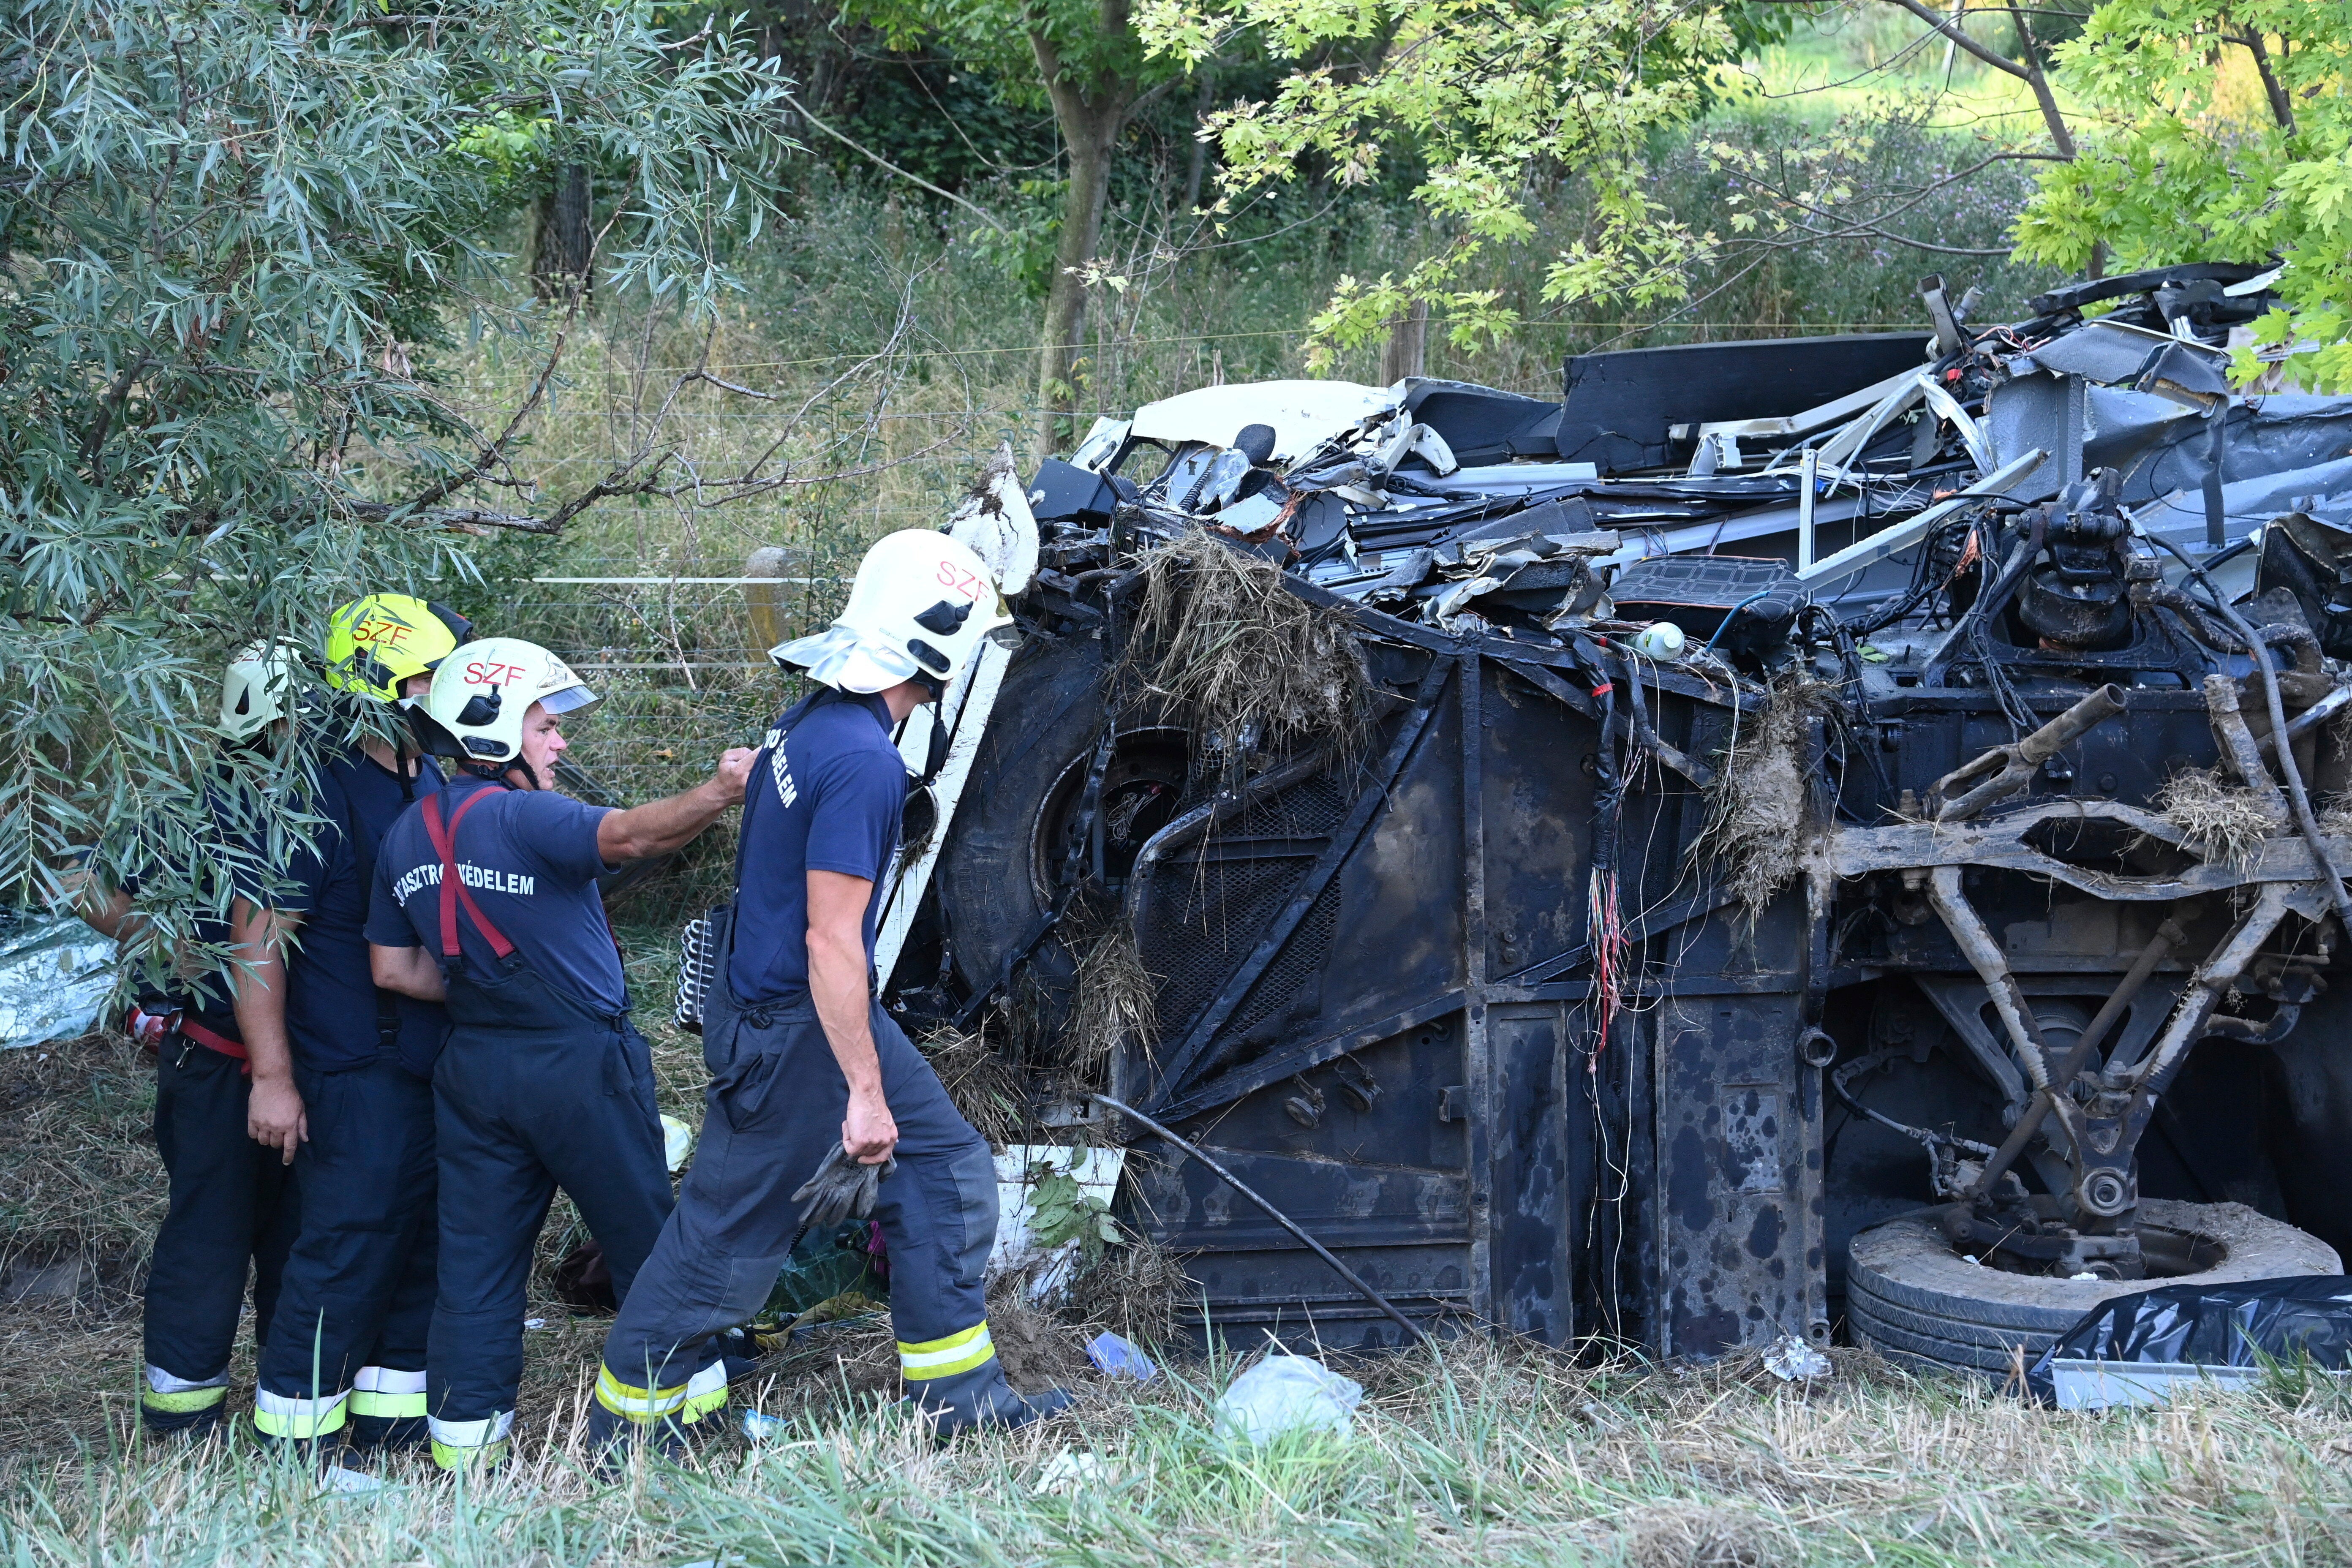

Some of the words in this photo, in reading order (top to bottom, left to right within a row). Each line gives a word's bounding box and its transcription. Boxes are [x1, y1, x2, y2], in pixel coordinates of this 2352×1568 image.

[937, 561, 989, 602] SZF
[353, 621, 412, 645] SZF
[464, 662, 525, 687] SZF
[392, 860, 534, 907] ATASZTRVÉDELEM
